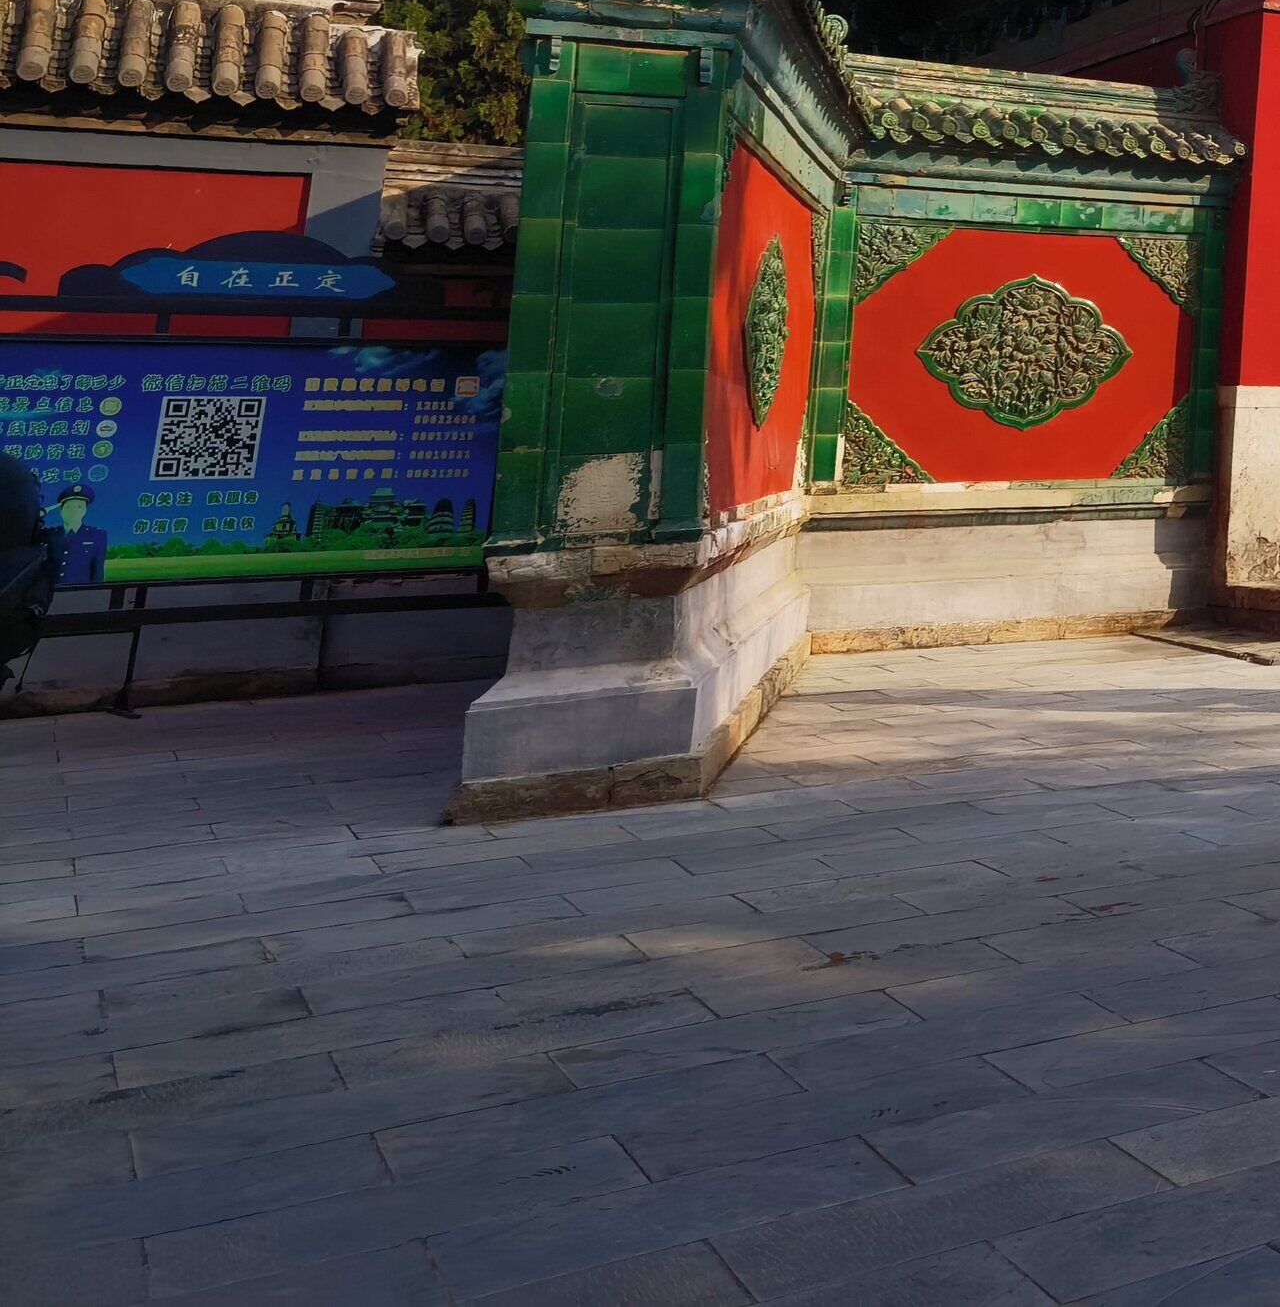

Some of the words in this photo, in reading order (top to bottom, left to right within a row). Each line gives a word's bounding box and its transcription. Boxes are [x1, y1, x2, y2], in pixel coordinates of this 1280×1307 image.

[176, 265, 346, 293] 自在正定
[141, 374, 292, 392] 微信扫描二维码
[0, 420, 90, 436] 线路规划
